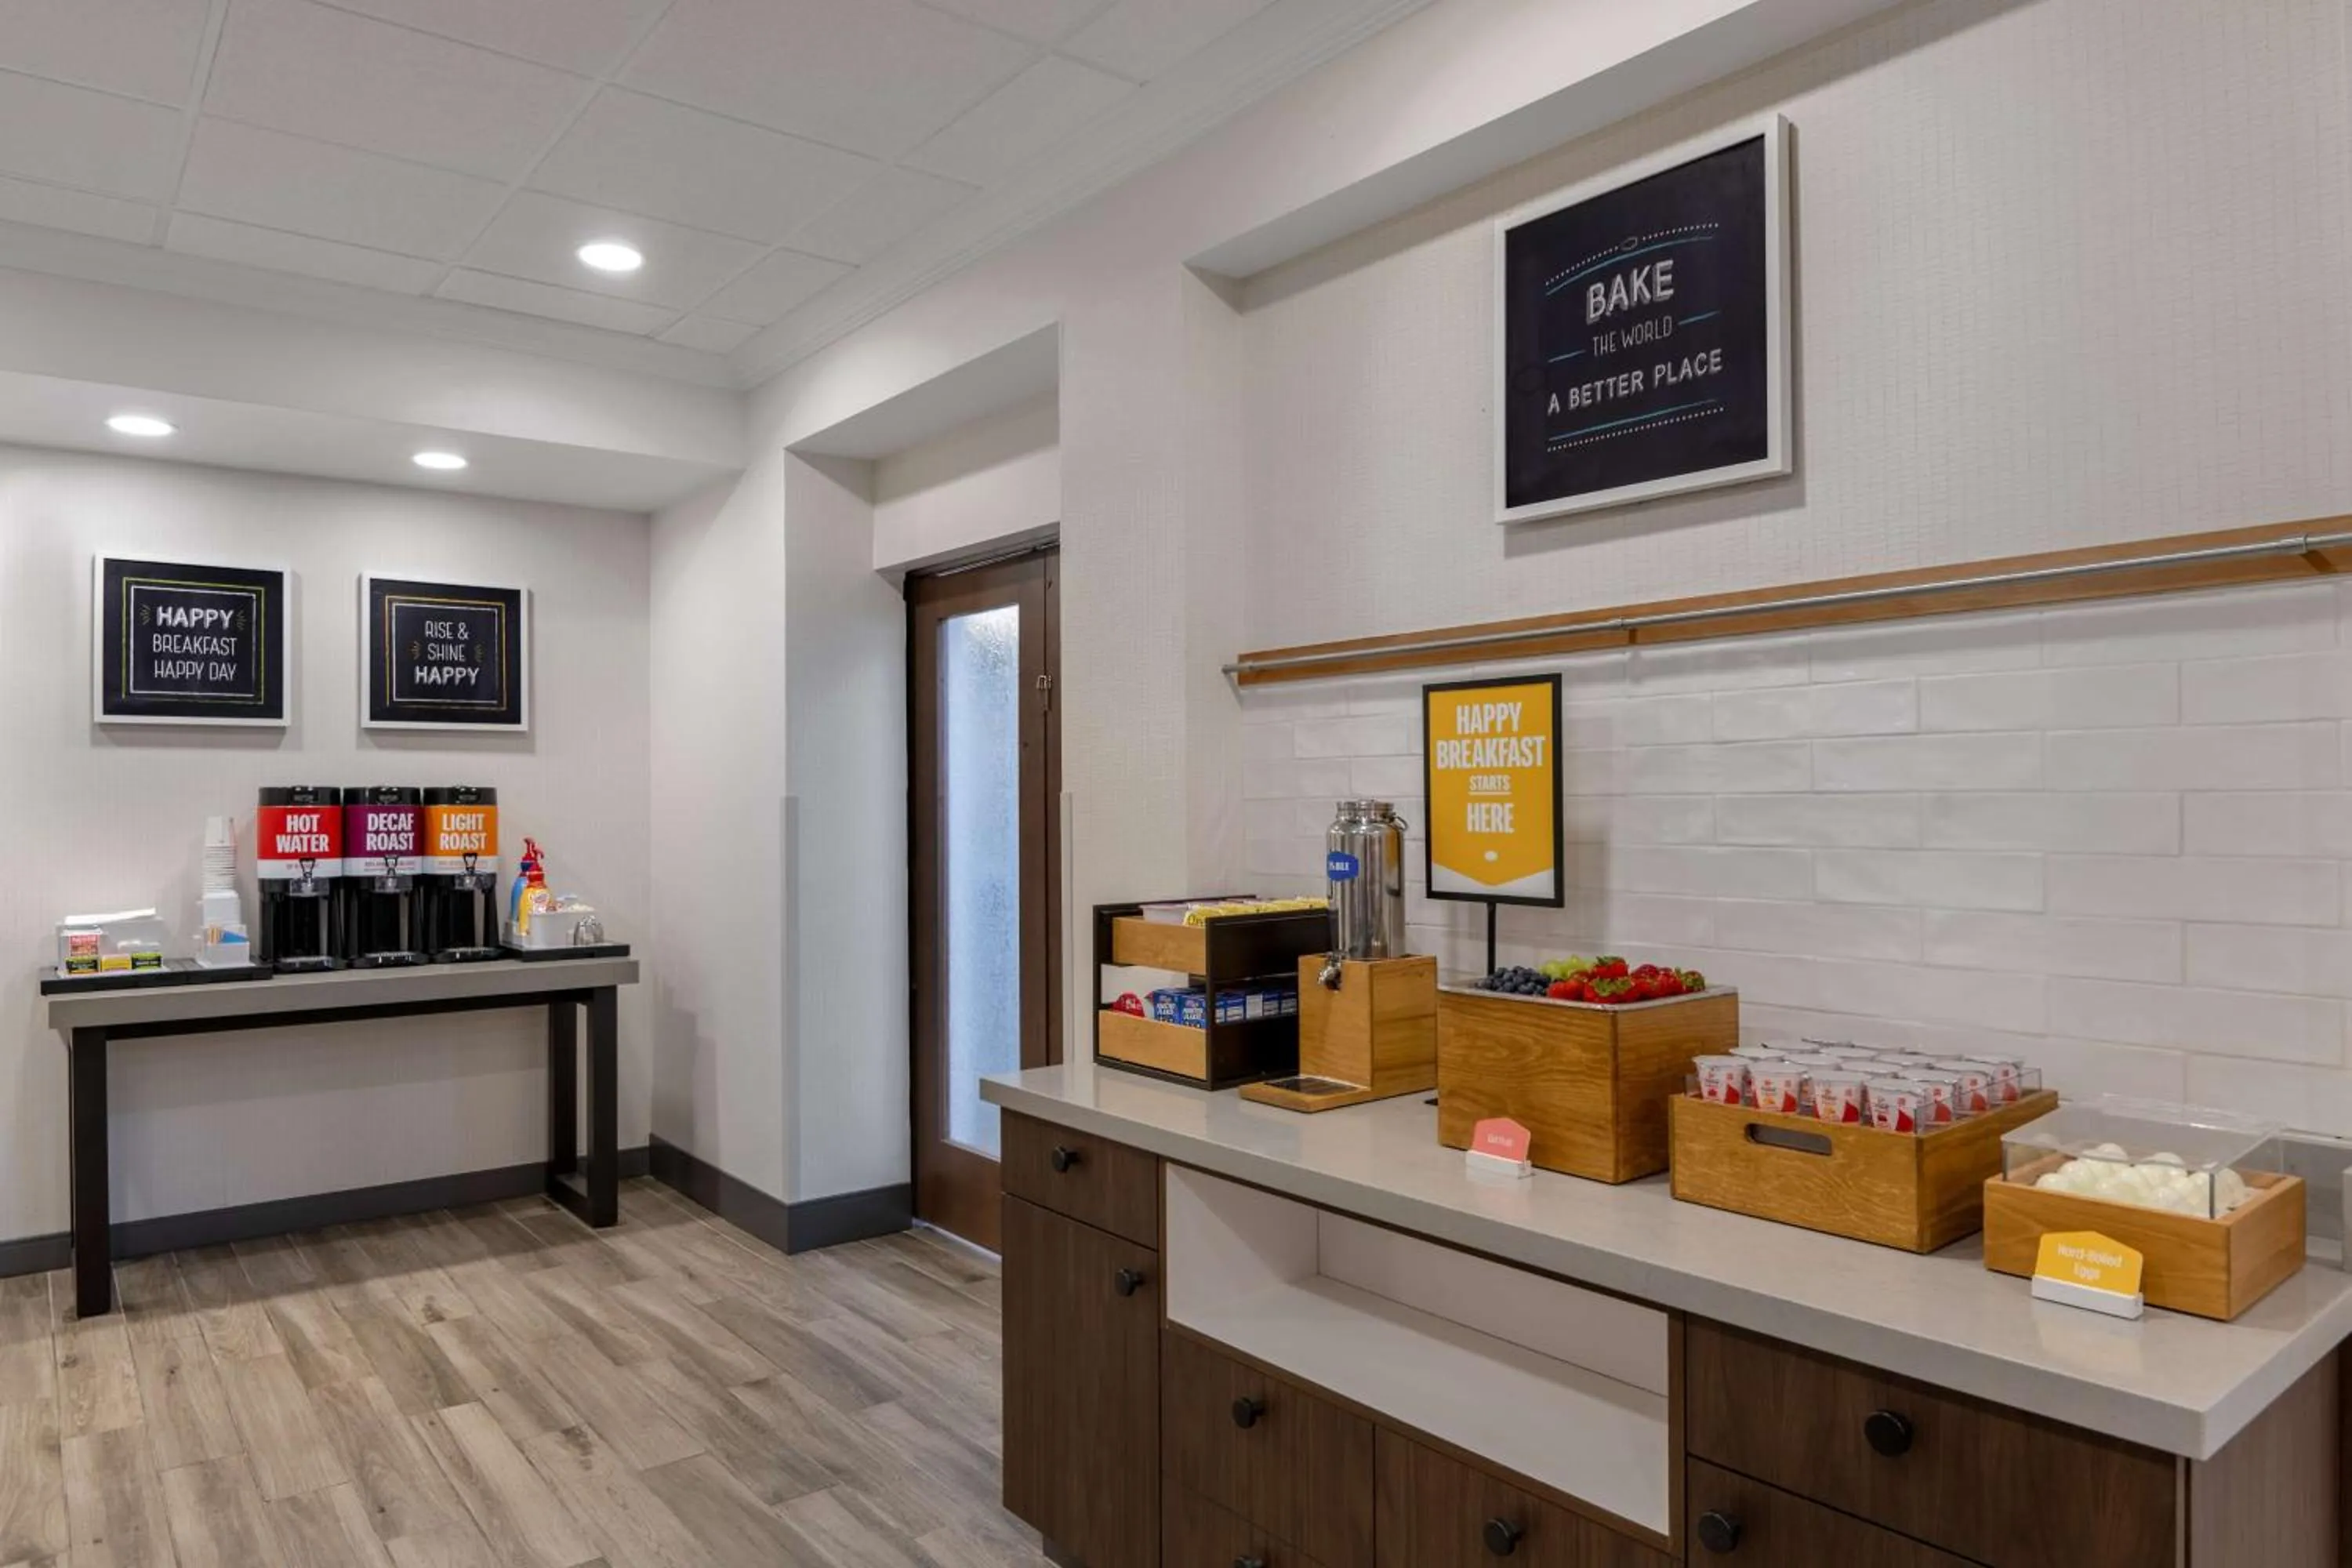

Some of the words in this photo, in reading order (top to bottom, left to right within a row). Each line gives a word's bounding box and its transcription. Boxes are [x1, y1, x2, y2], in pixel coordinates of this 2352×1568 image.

[1586, 259, 1674, 325] BAKE
[1592, 331, 1617, 357] THE
[1621, 315, 1673, 348] WORLD
[1547, 393, 1560, 416] A
[1570, 370, 1645, 409] BETTER
[1653, 348, 1722, 388] PLACE
[157, 606, 234, 629] HAPPY
[425, 620, 453, 640] RISE
[458, 622, 469, 640] &
[153, 633, 237, 656] BREAKFAST
[427, 643, 466, 662] SHINE
[154, 660, 204, 680] HAPPY
[209, 662, 237, 681] DAY
[414, 665, 480, 686] HAPPY
[1456, 702, 1523, 735] HAPPY
[1436, 735, 1546, 770] BREAKFAST
[1468, 775, 1512, 791] STARTS
[286, 814, 320, 833] HOT
[367, 813, 414, 831] DECAF
[442, 813, 485, 831] LIGHT
[1467, 802, 1515, 833] HERE
[276, 834, 329, 853] WATER
[366, 832, 414, 851] ROAST
[440, 832, 487, 851] ROAST
